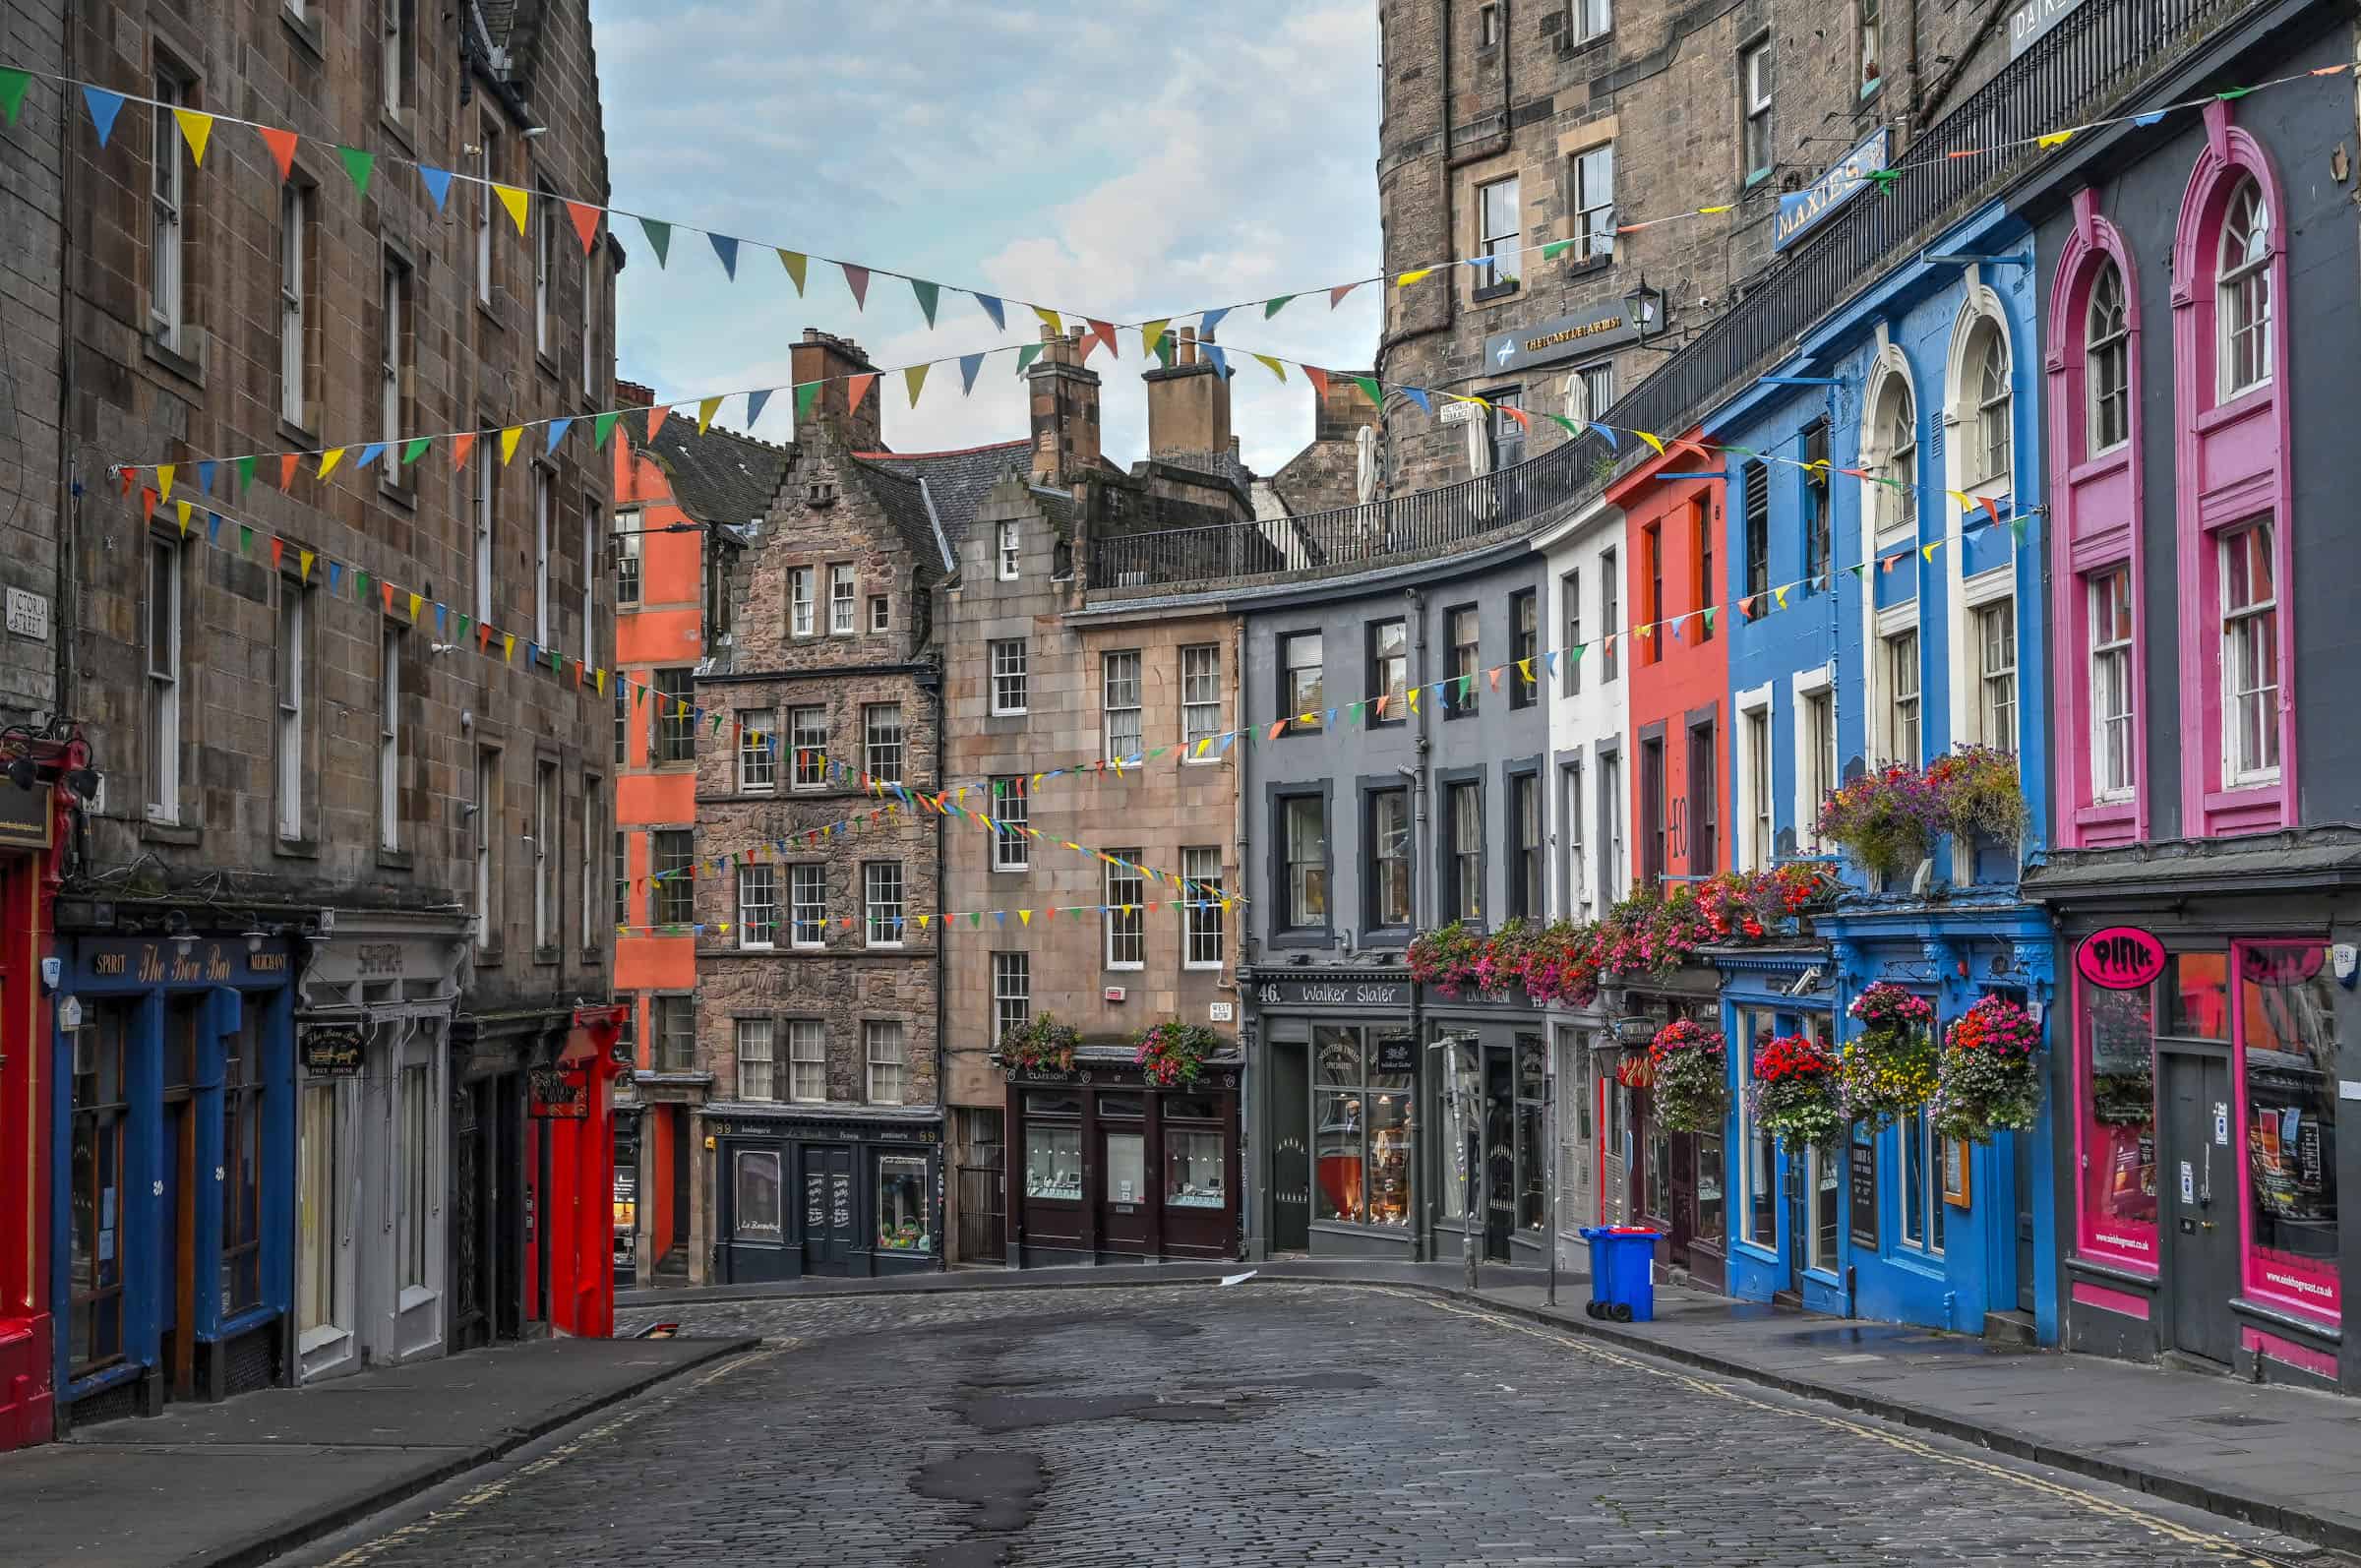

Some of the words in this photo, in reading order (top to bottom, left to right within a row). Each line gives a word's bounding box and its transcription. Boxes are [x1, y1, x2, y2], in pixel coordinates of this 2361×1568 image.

[1778, 157, 1859, 242] MAXIES
[15, 612, 41, 633] STREET
[1669, 796, 1687, 858] 40
[96, 954, 126, 975] SPIRIT
[138, 943, 165, 984] The
[206, 943, 231, 983] Bar
[251, 953, 287, 971] MERCHANT
[1302, 984, 1349, 1001] Walker
[1357, 984, 1396, 1001] Slater
[1212, 1003, 1230, 1012] WEST
[716, 1123, 732, 1134] 89
